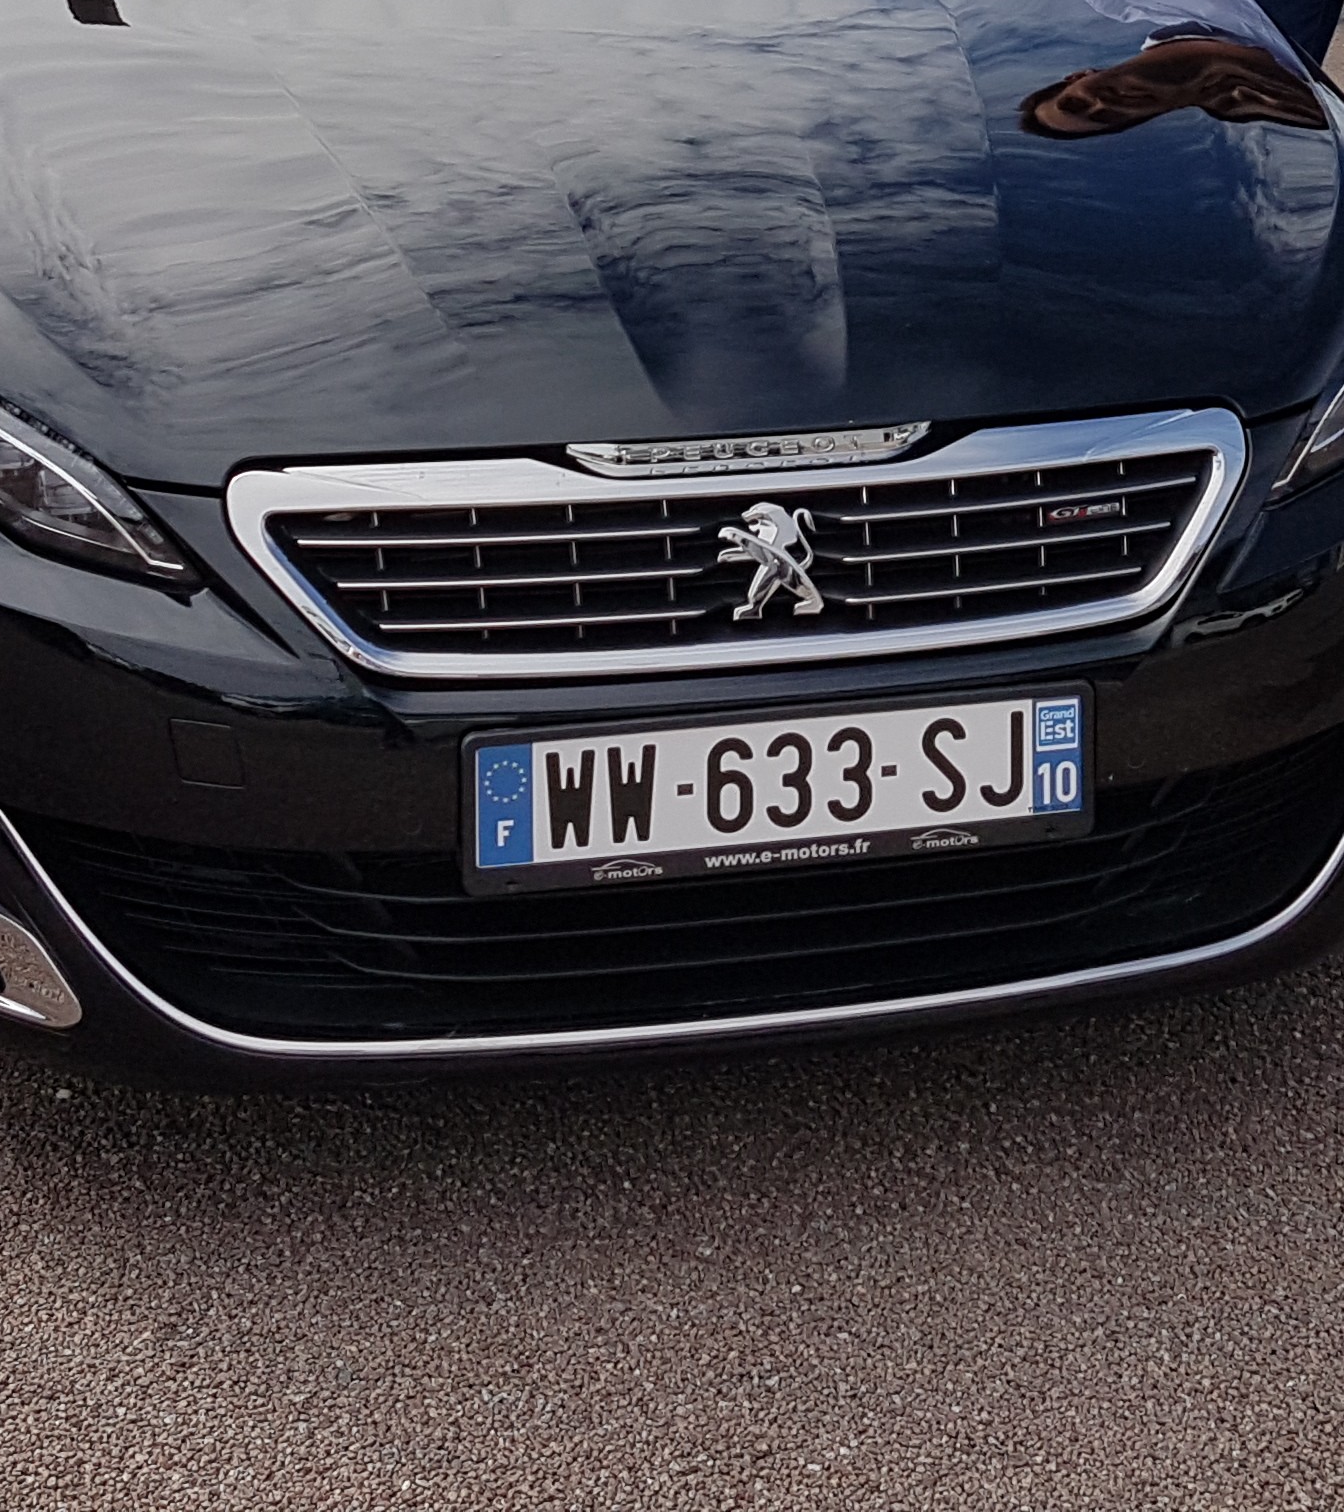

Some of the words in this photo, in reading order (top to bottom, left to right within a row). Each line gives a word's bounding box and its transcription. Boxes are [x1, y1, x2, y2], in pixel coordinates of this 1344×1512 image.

[649, 433, 863, 464] PEUGEOT
[1040, 707, 1076, 721] Grand
[1040, 719, 1075, 741] Est
[1038, 760, 1077, 805] 10
[496, 819, 515, 848] F
[705, 839, 871, 870] www.e-motors.fr
